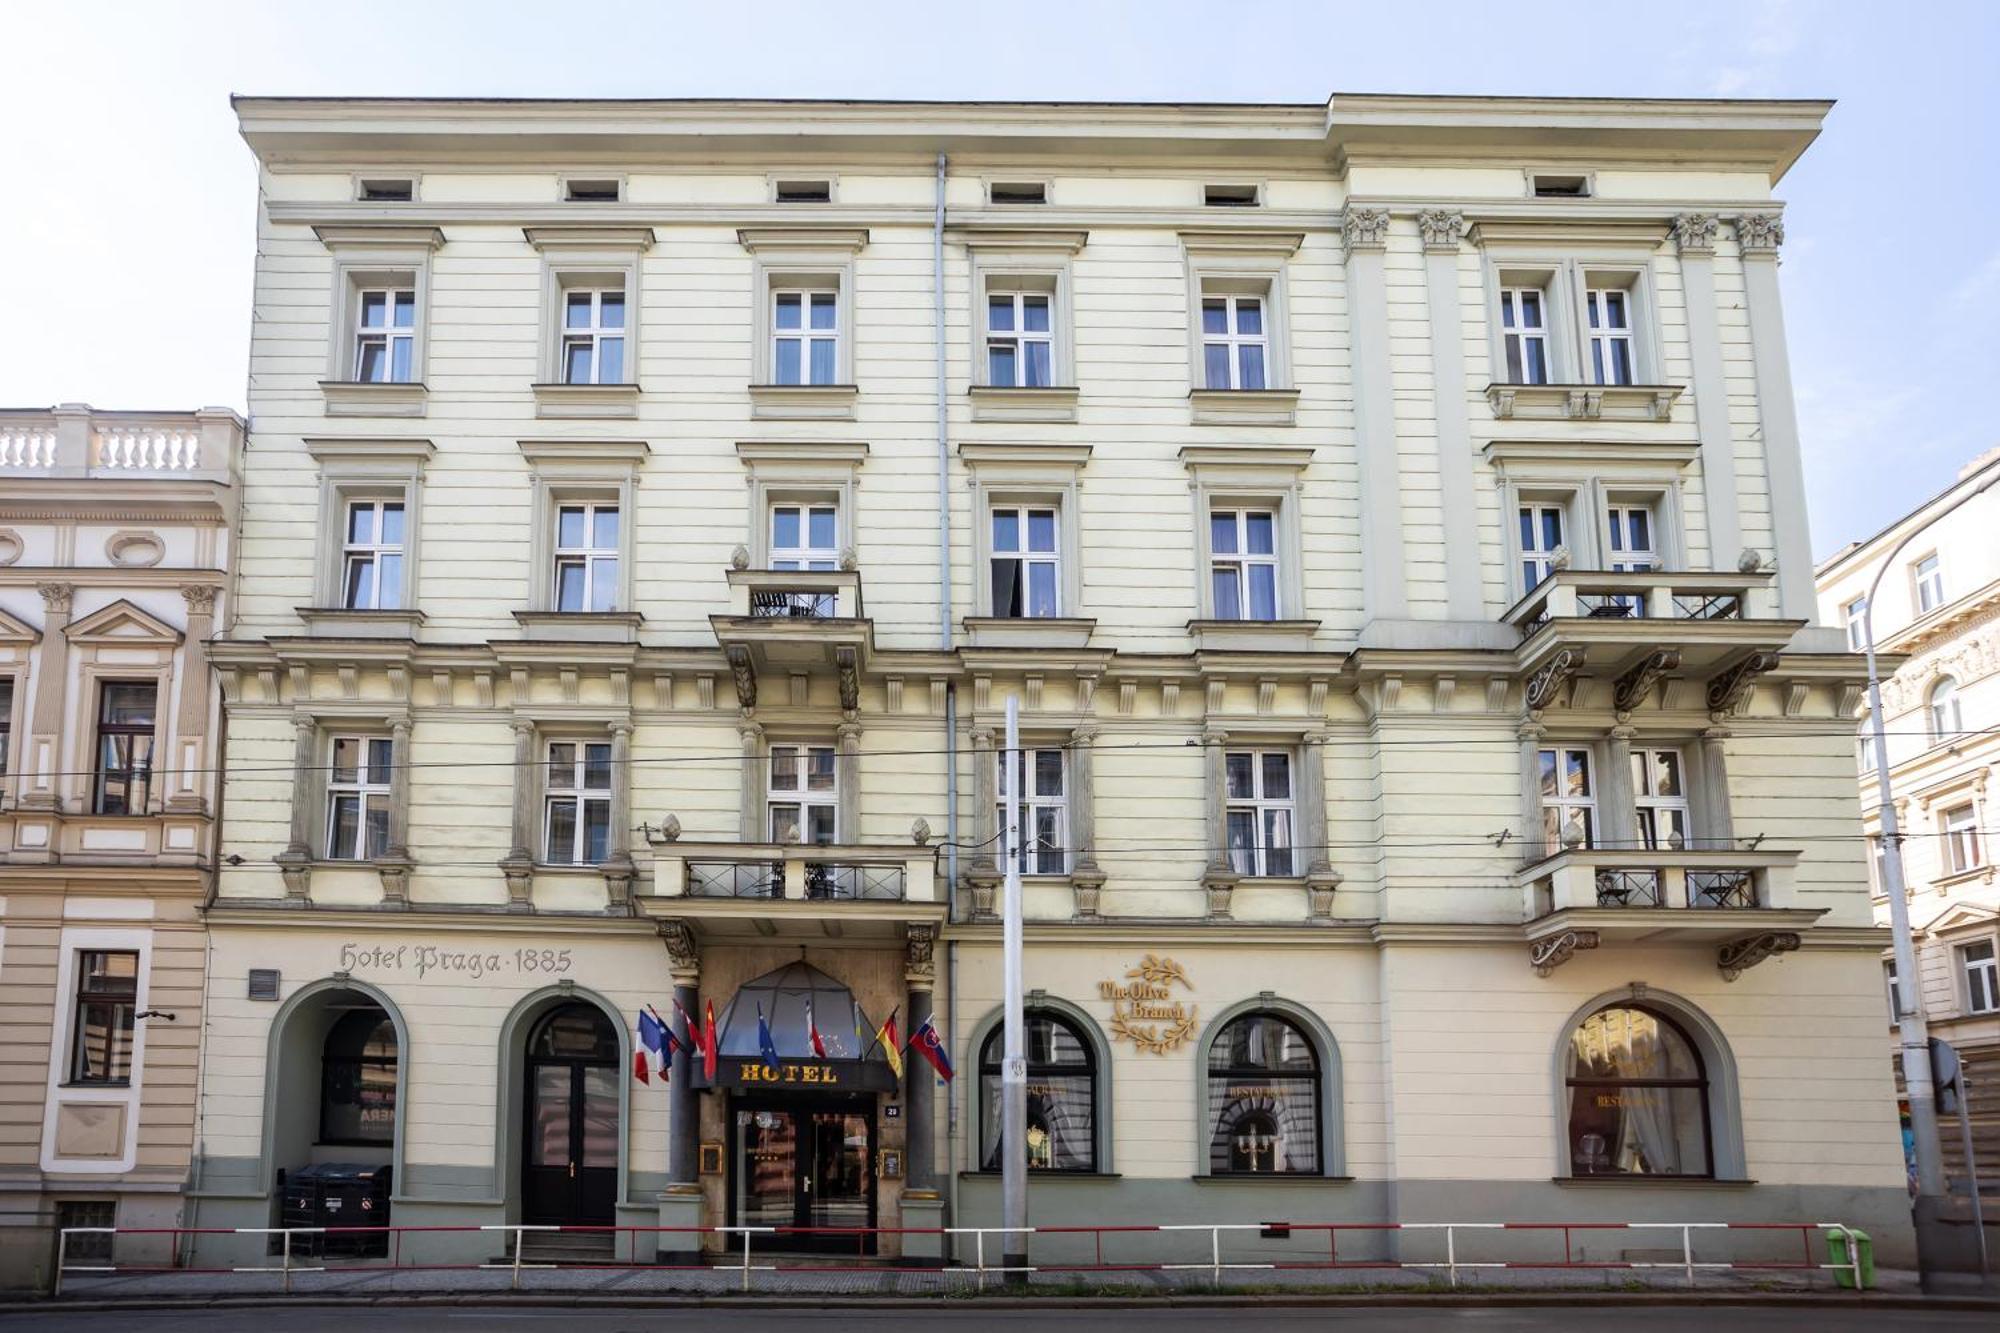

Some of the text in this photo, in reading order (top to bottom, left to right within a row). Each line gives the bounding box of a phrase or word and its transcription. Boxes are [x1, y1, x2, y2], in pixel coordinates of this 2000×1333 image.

[340, 943, 573, 979] Hotel Praga 1885
[1098, 981, 1170, 1001] The Olive
[1131, 1002, 1185, 1020] Branch
[740, 1064, 837, 1082] HOTEL
